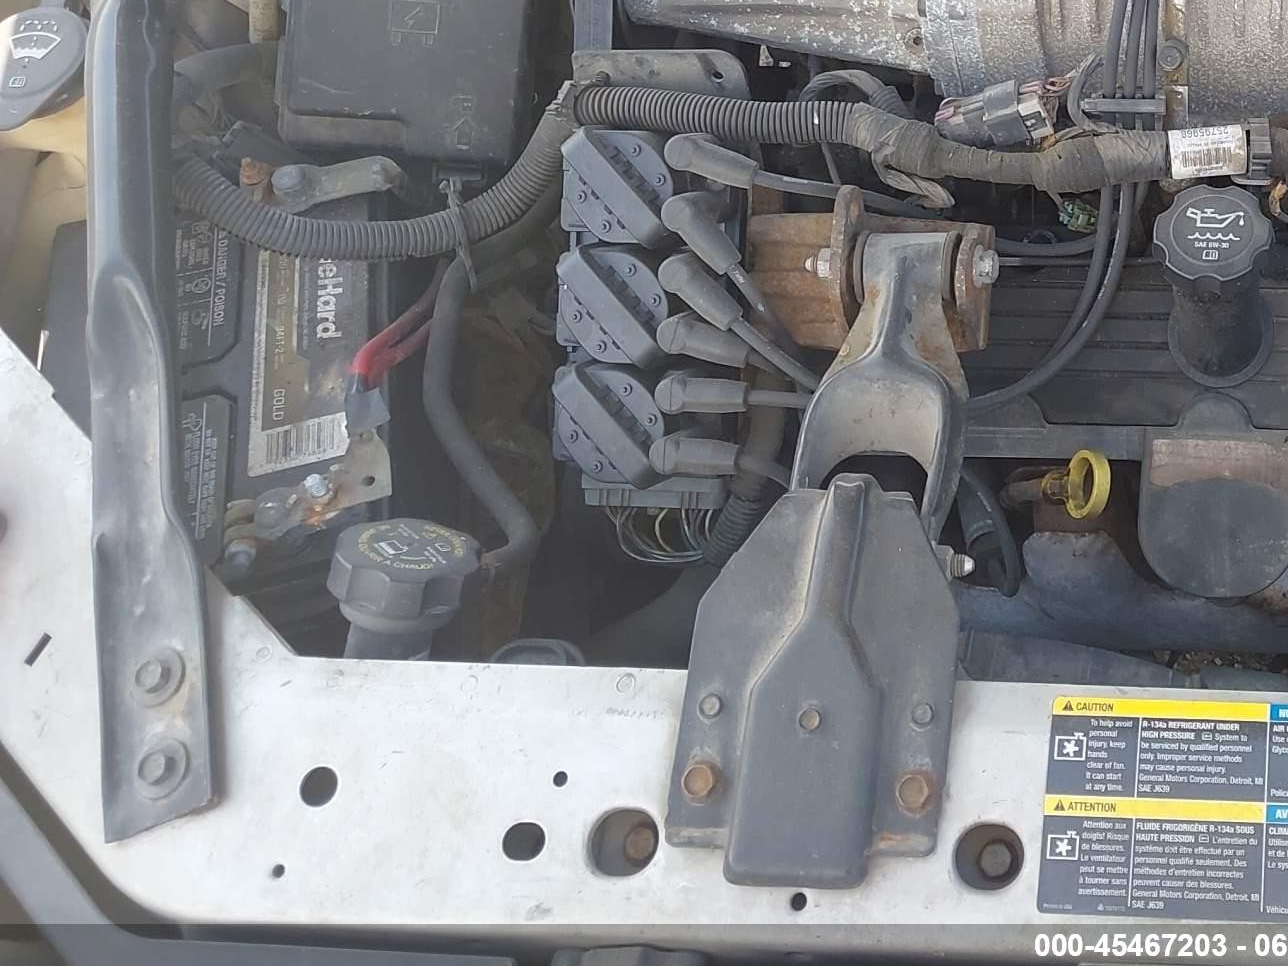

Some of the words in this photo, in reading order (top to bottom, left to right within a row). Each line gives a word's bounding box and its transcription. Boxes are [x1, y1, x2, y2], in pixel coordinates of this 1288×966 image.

[1208, 241, 1230, 249] 5W-30
[216, 239, 228, 280] DANGER
[213, 288, 226, 327] POISON
[272, 388, 286, 421] GOLD
[1075, 702, 1114, 712] CAUTION
[1156, 753, 1187, 761] Improper
[1176, 764, 1205, 772] personal
[1067, 801, 1116, 812] ATTENTION
[1160, 834, 1194, 842] PRESSION
